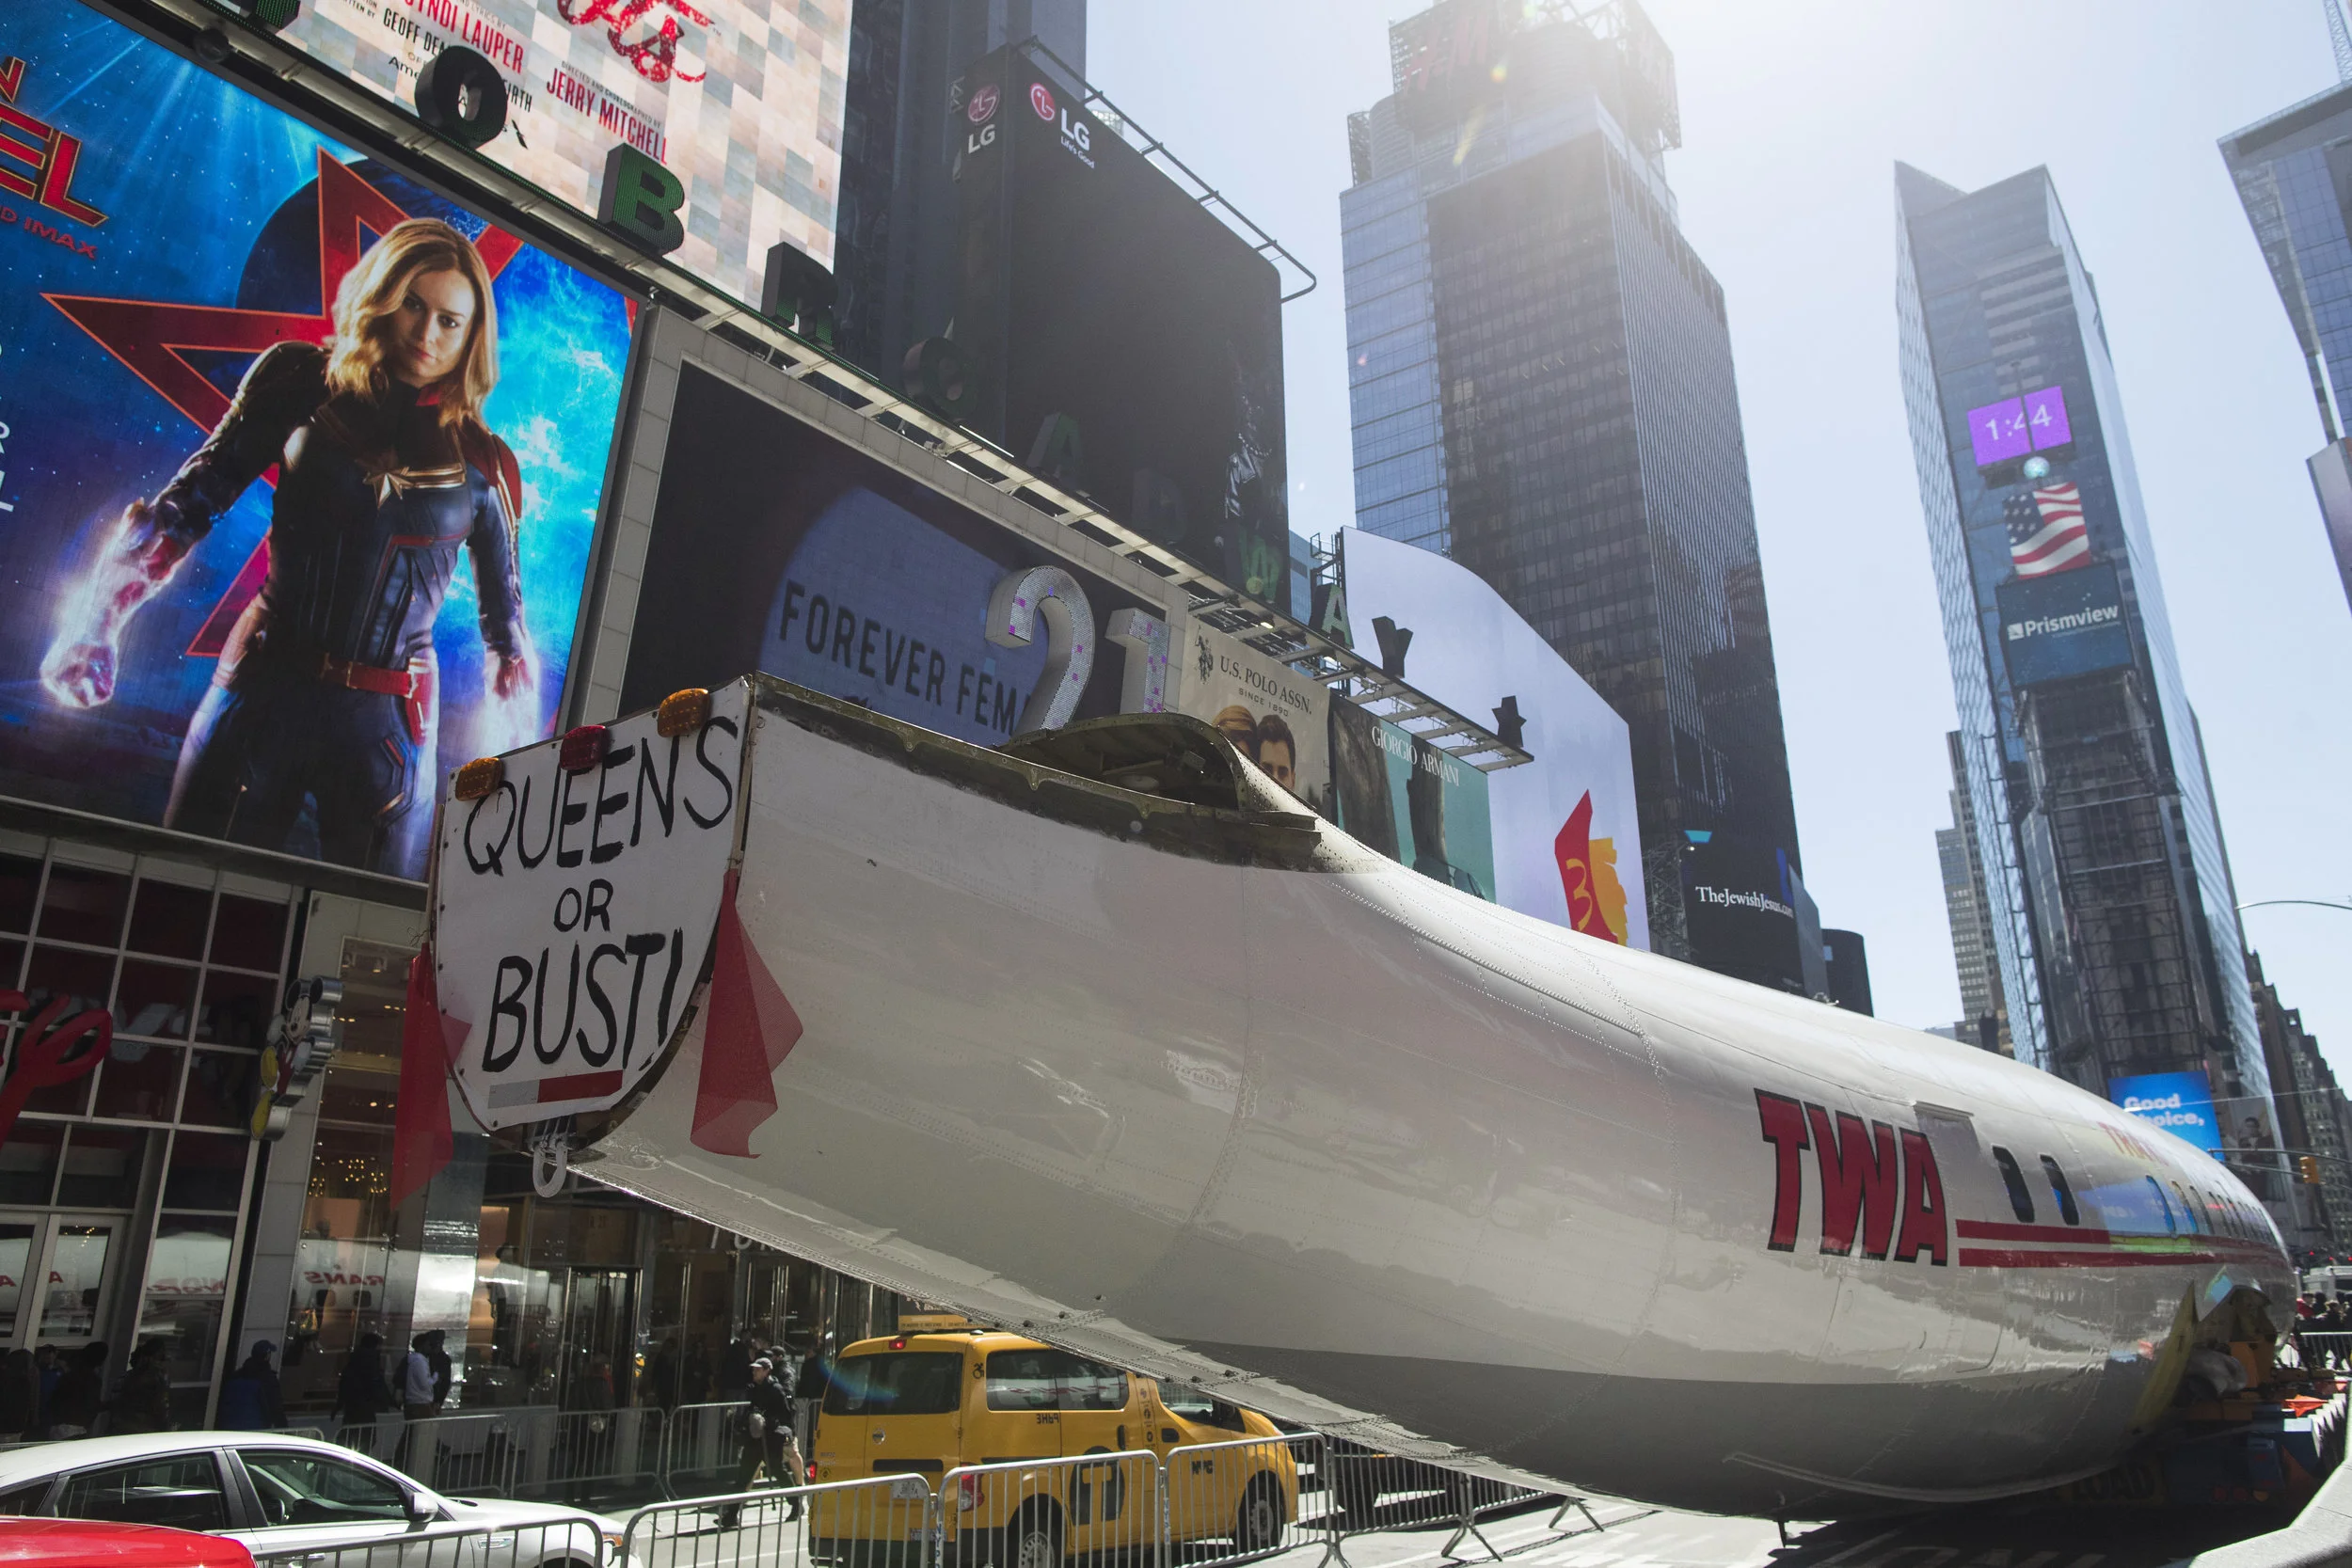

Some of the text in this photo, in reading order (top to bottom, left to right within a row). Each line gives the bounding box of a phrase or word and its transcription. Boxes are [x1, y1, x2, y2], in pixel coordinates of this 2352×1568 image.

[383, 8, 421, 43] GEOFF
[461, 12, 524, 74] LAUPER
[547, 68, 596, 118] JERRY
[598, 98, 668, 166] MITCHELL
[968, 123, 996, 154] LG
[1060, 107, 1090, 151] LG
[1060, 136, 1095, 169] Life's Good
[24, 216, 97, 261] IMAX
[1985, 404, 2054, 442] 1:44
[777, 578, 947, 707] FOREVER
[2024, 605, 2120, 637] Prismview
[985, 564, 1171, 732] 21
[1220, 656, 1313, 715] U.S. POLO ASSN.
[1238, 688, 1289, 718] SINCE 1890
[1372, 726, 1460, 787] GIORGIO ARMANI
[463, 716, 739, 878] QUEENS
[553, 878, 615, 933] OR
[1694, 886, 1794, 919] TheJewishJesus.com
[482, 927, 685, 1073] BUST!
[2123, 1093, 2182, 1111] Good
[1754, 1087, 1949, 1268] TWA
